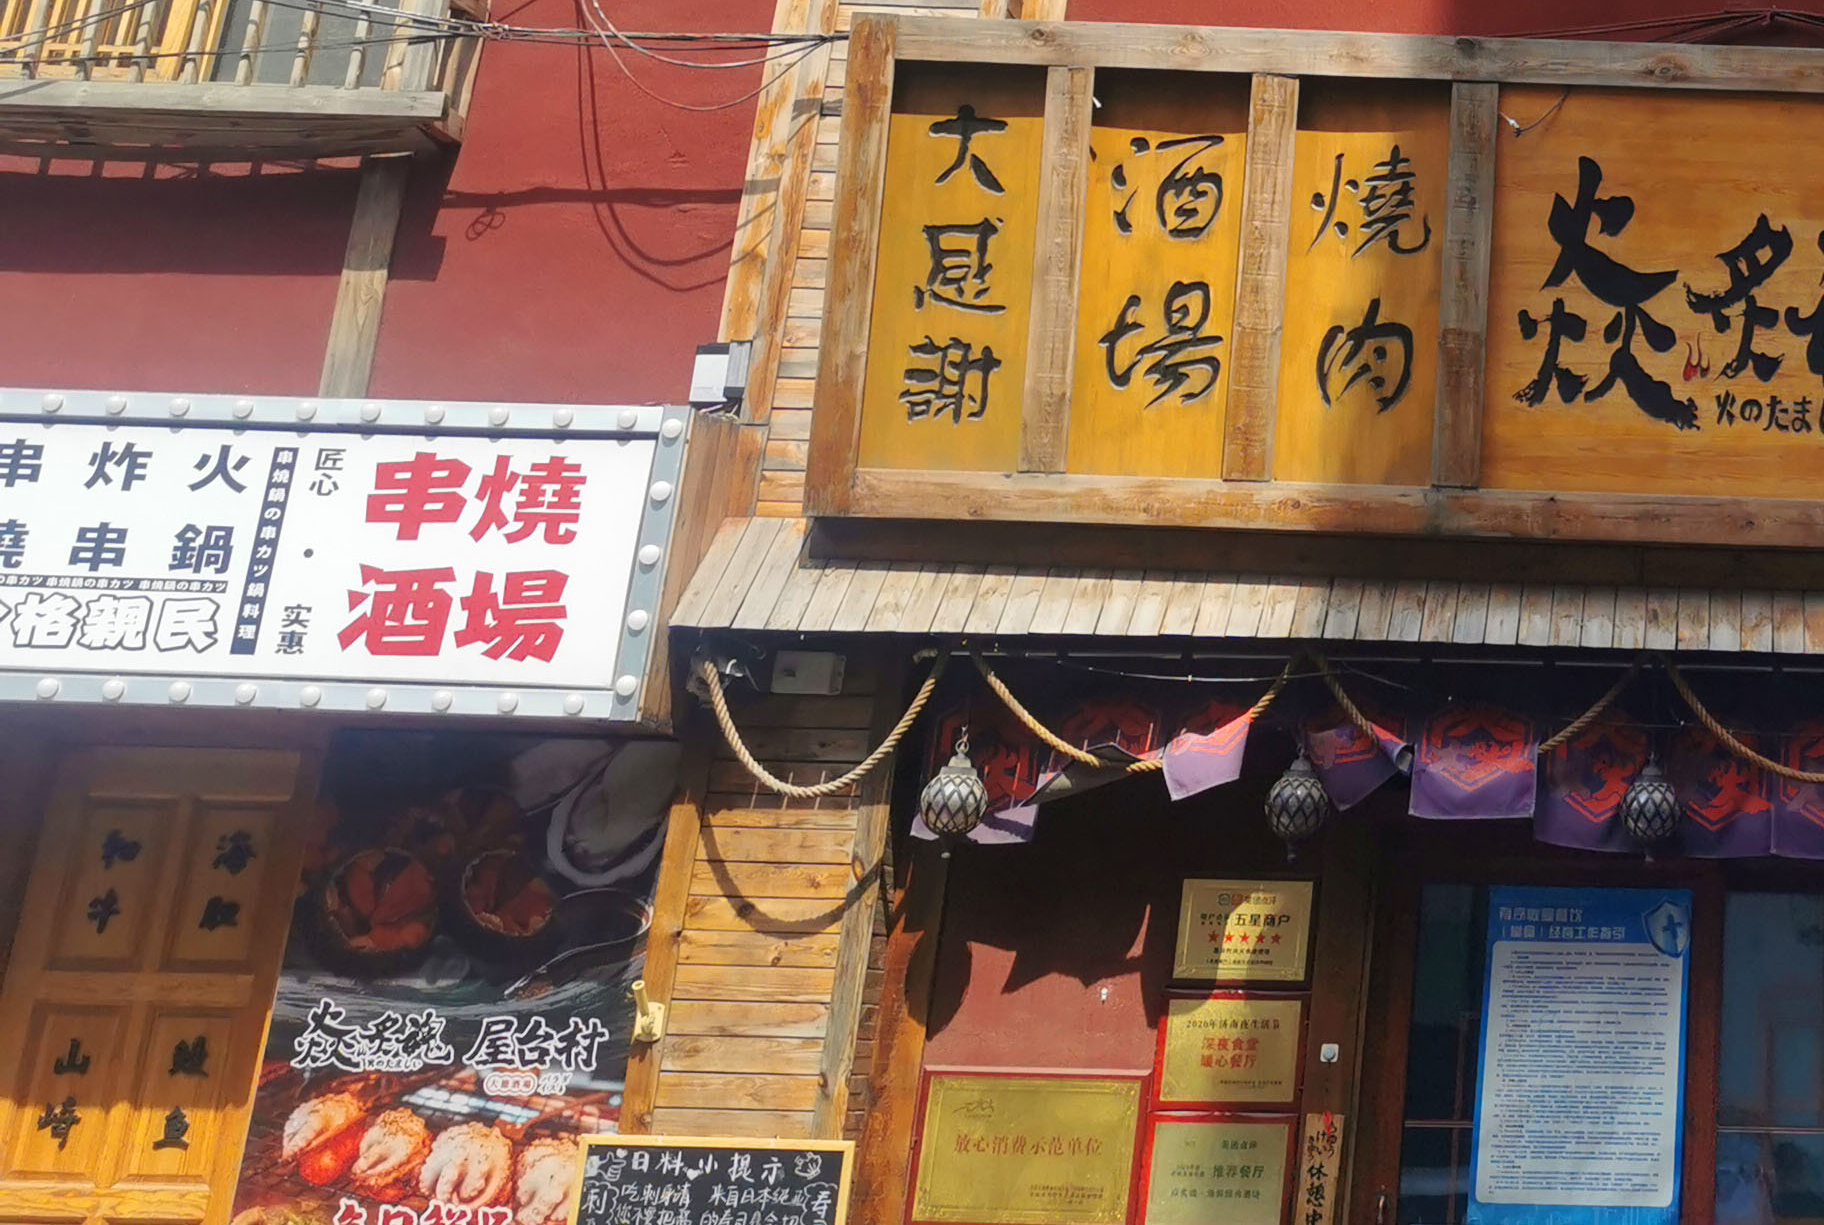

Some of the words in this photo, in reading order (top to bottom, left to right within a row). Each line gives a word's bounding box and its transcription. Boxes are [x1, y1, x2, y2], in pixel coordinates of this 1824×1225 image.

[1098, 134, 1225, 410] 酒場
[1307, 144, 1433, 414] 燒肉
[365, 451, 588, 545] 串燒
[0, 591, 220, 654] 格親民
[339, 563, 569, 663] 酒場
[462, 1015, 610, 1072] 屋台村
[631, 1150, 784, 1185] 日料小提示
[954, 1134, 1103, 1156] 放心消费示范单位
